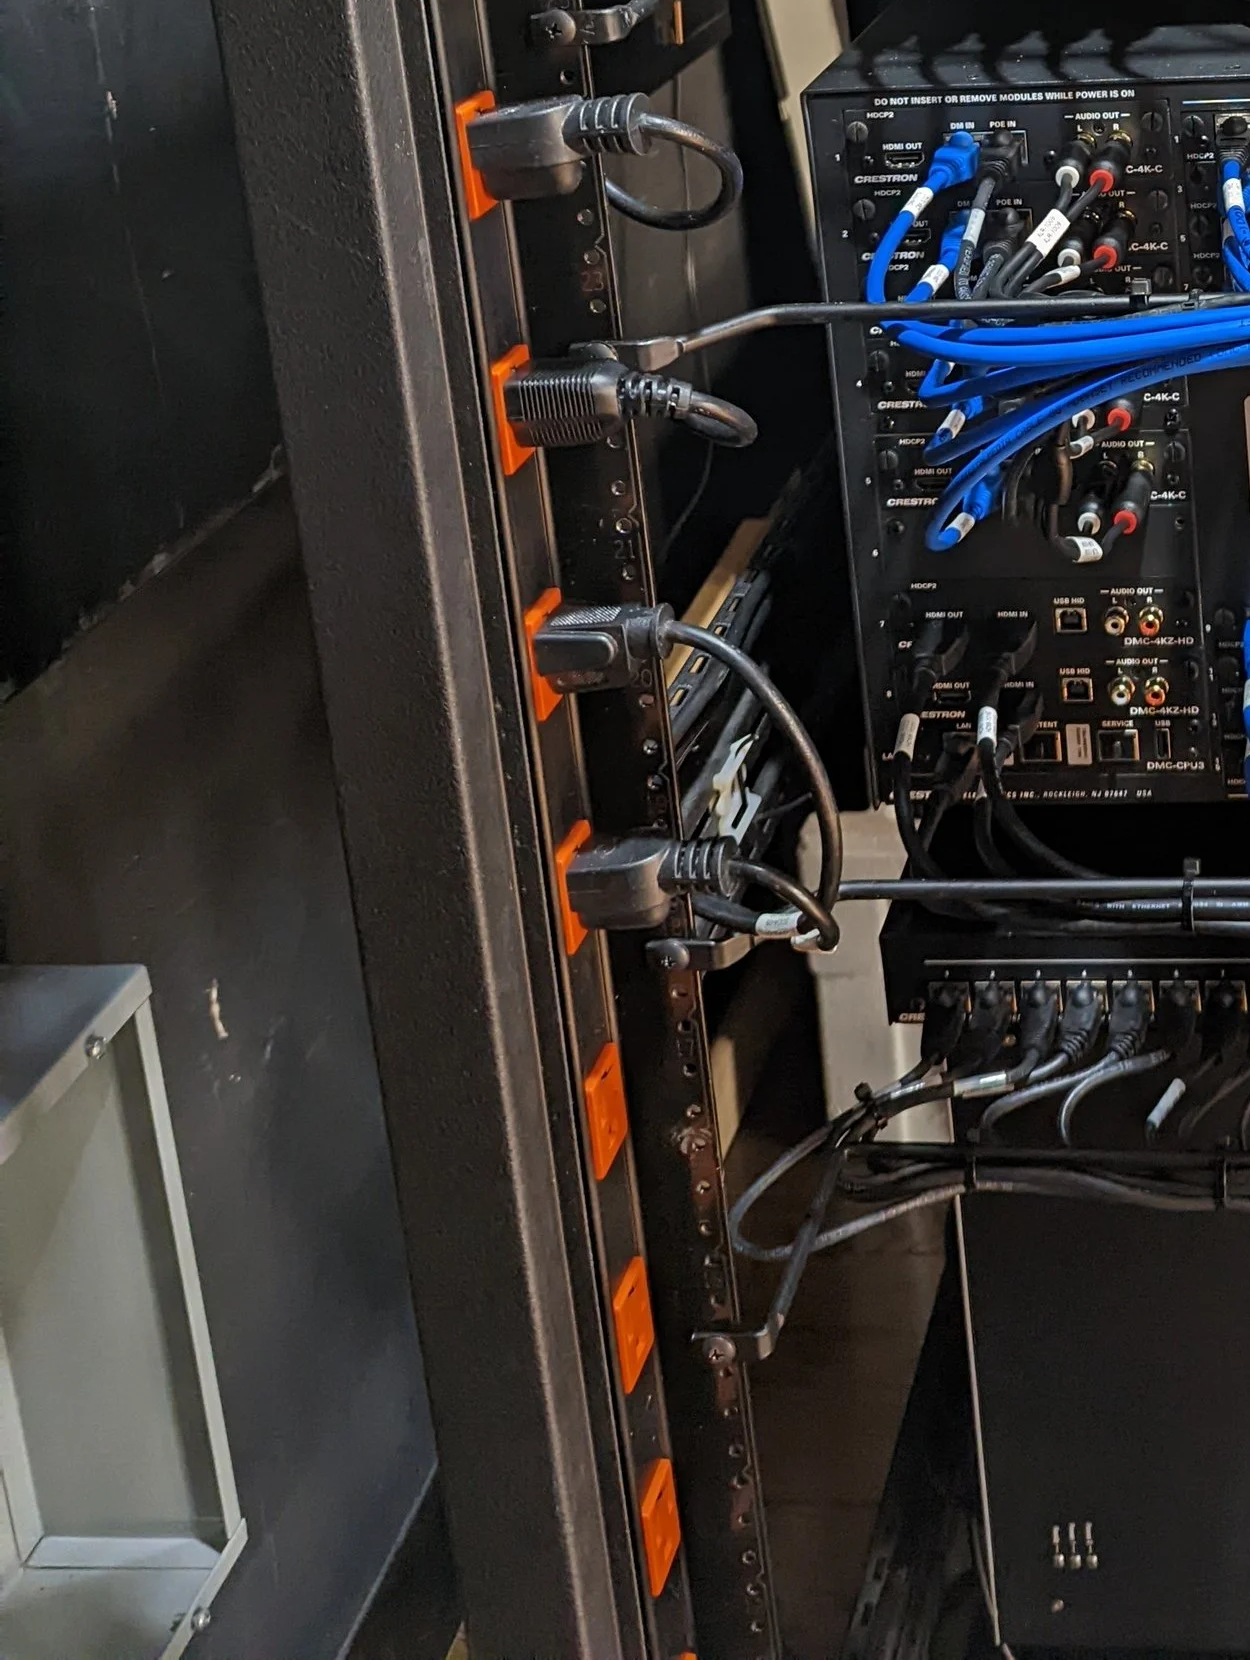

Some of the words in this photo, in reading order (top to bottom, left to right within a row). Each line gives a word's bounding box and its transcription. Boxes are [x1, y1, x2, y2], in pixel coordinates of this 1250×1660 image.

[874, 97, 888, 106] DO
[890, 97, 909, 105] NOT
[911, 96, 942, 104] INSERT
[959, 94, 997, 103] REMOVE
[1000, 93, 1043, 102] MODULES
[1045, 92, 1073, 101] WHILE
[1076, 91, 1107, 99] POWER
[1109, 90, 1117, 98] IS
[1075, 112, 1100, 120] AUDIO
[905, 142, 922, 150] OUT
[855, 174, 917, 183] CRESTRON
[1111, 587, 1135, 595] AUDIO
[1137, 587, 1153, 595] OUT
[1124, 636, 1194, 645] DMC-4KZ-HD
[1142, 657, 1158, 665] OUT
[1130, 706, 1200, 715] DMC-4KZ-HD
[1147, 761, 1205, 771] DMC-CPU3
